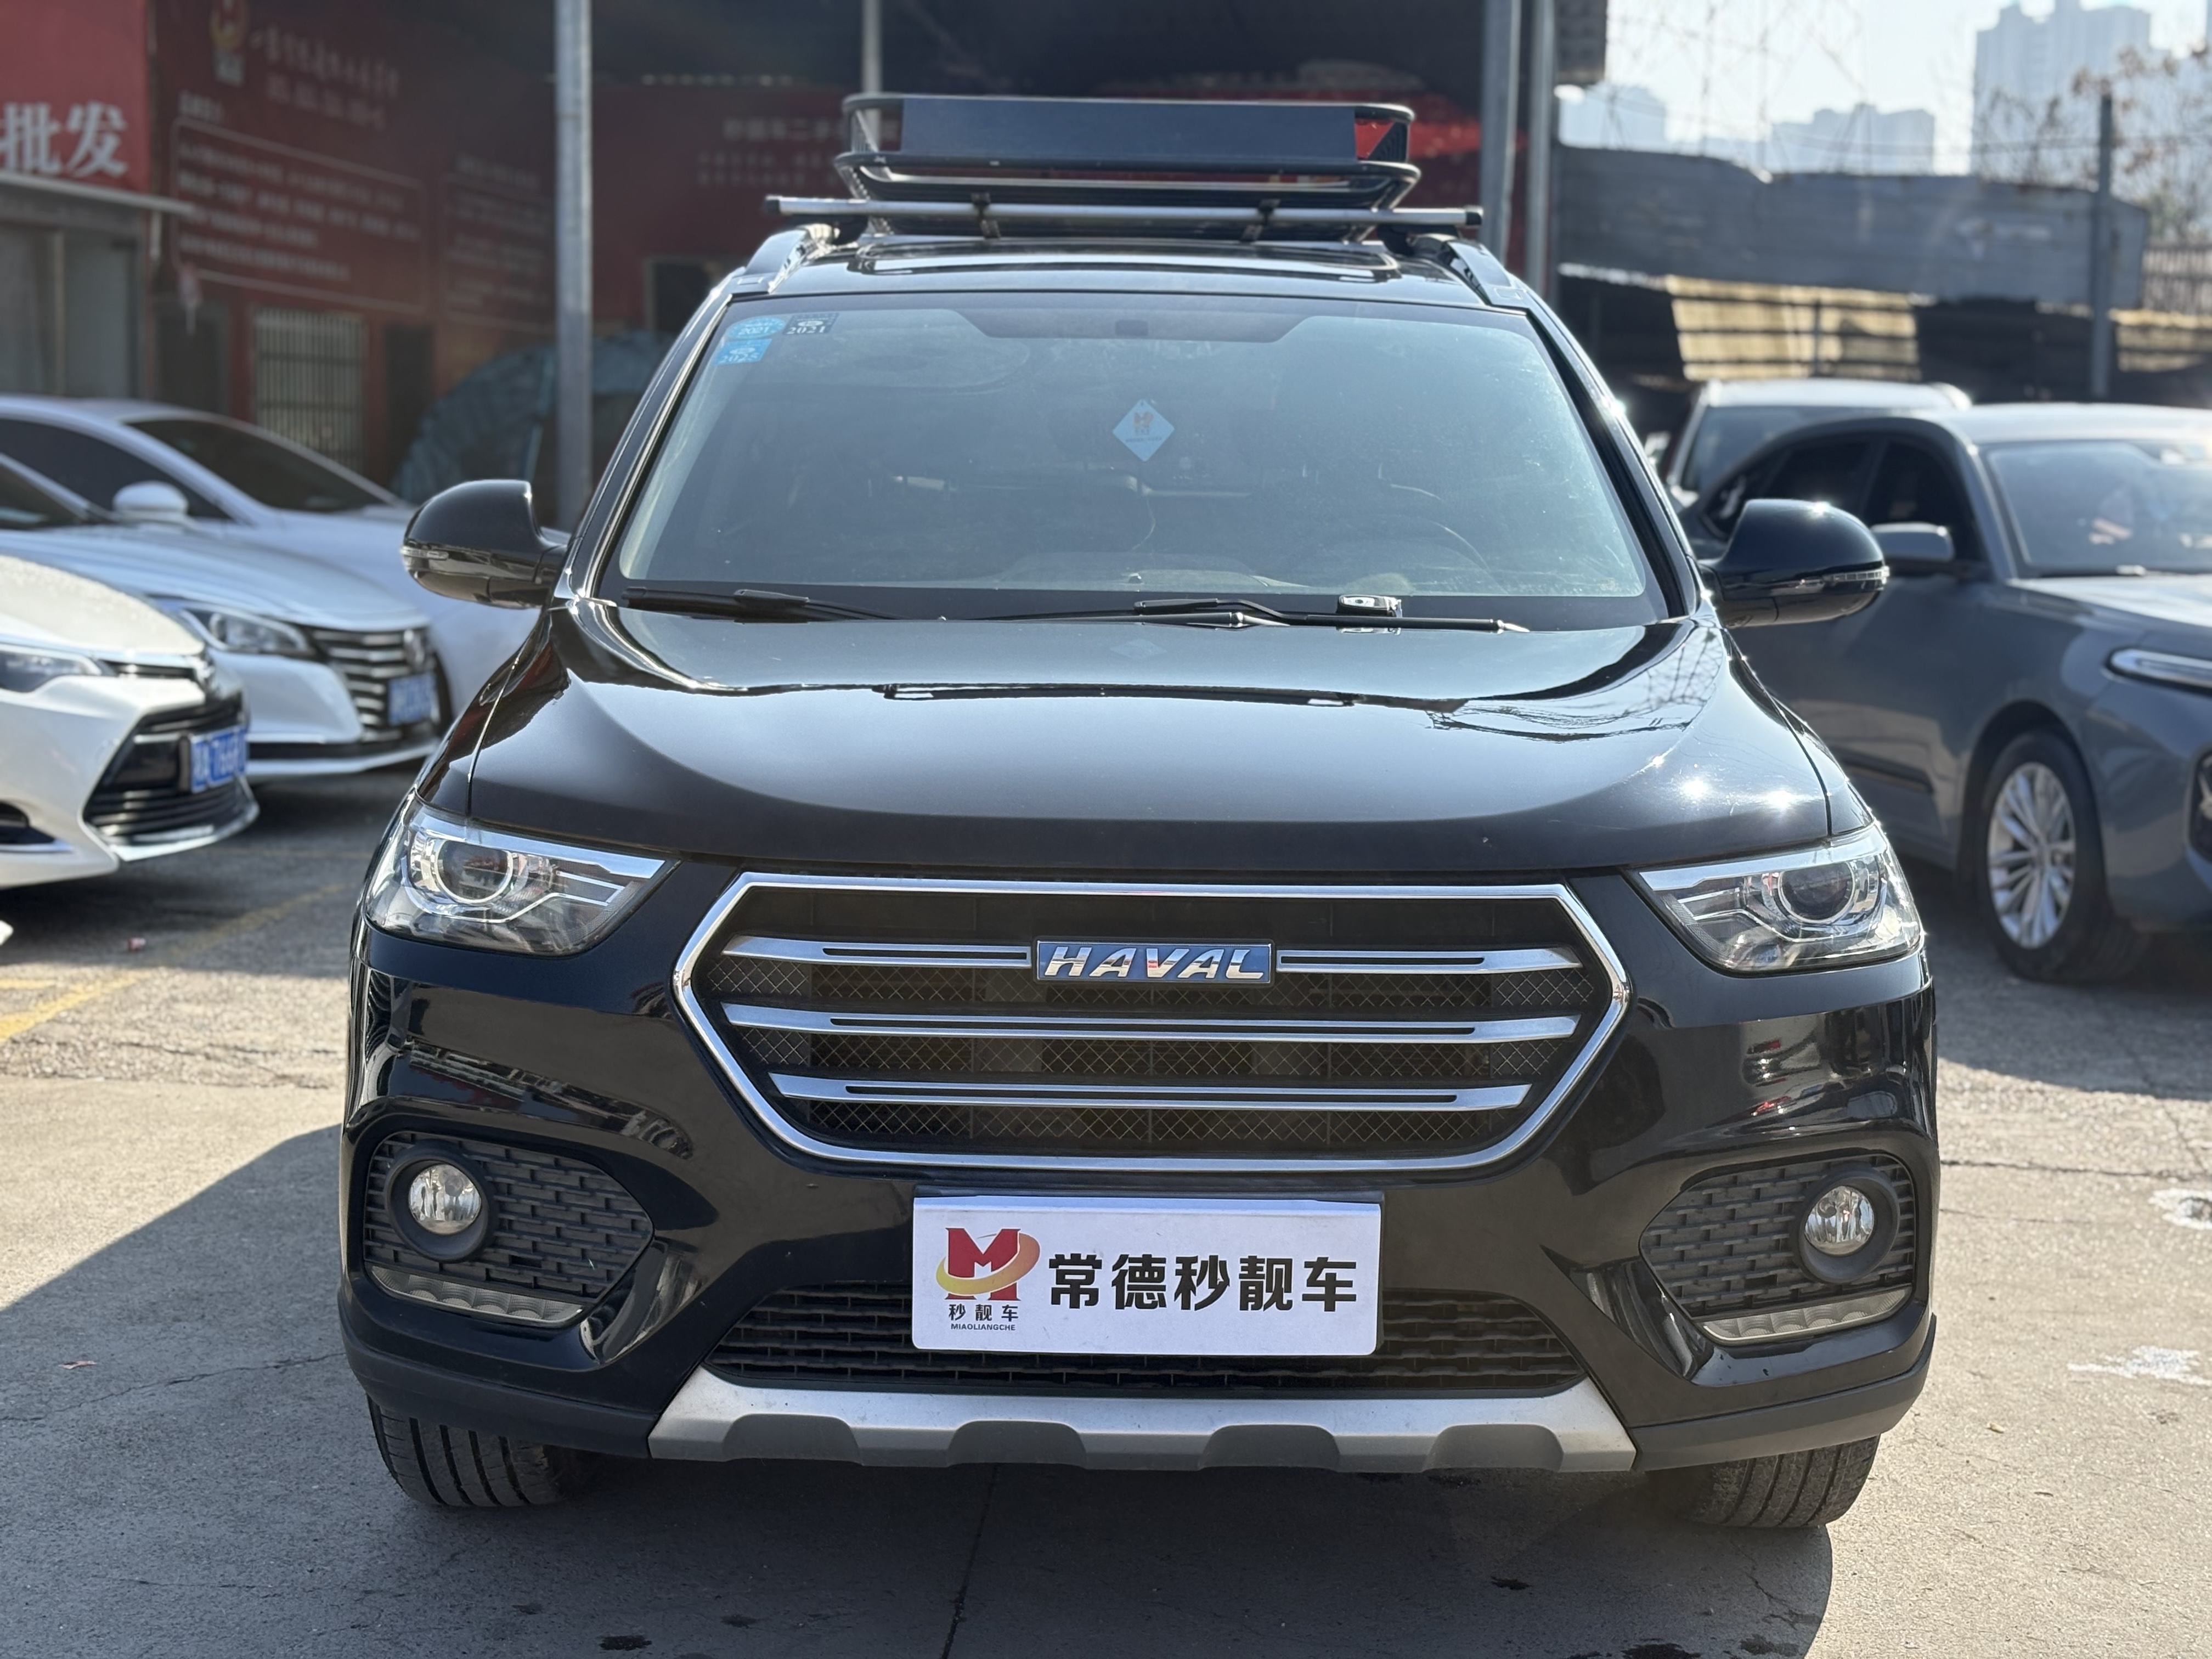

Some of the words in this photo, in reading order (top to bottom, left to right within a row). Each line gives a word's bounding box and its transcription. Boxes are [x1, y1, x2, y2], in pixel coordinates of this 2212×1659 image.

[0, 100, 128, 178] 批发
[787, 326, 826, 334] 2021
[1044, 946, 1265, 980] HAVAL
[1048, 1254, 1358, 1312] 常德秒靓车
[949, 1304, 1019, 1322] 秒靓车
